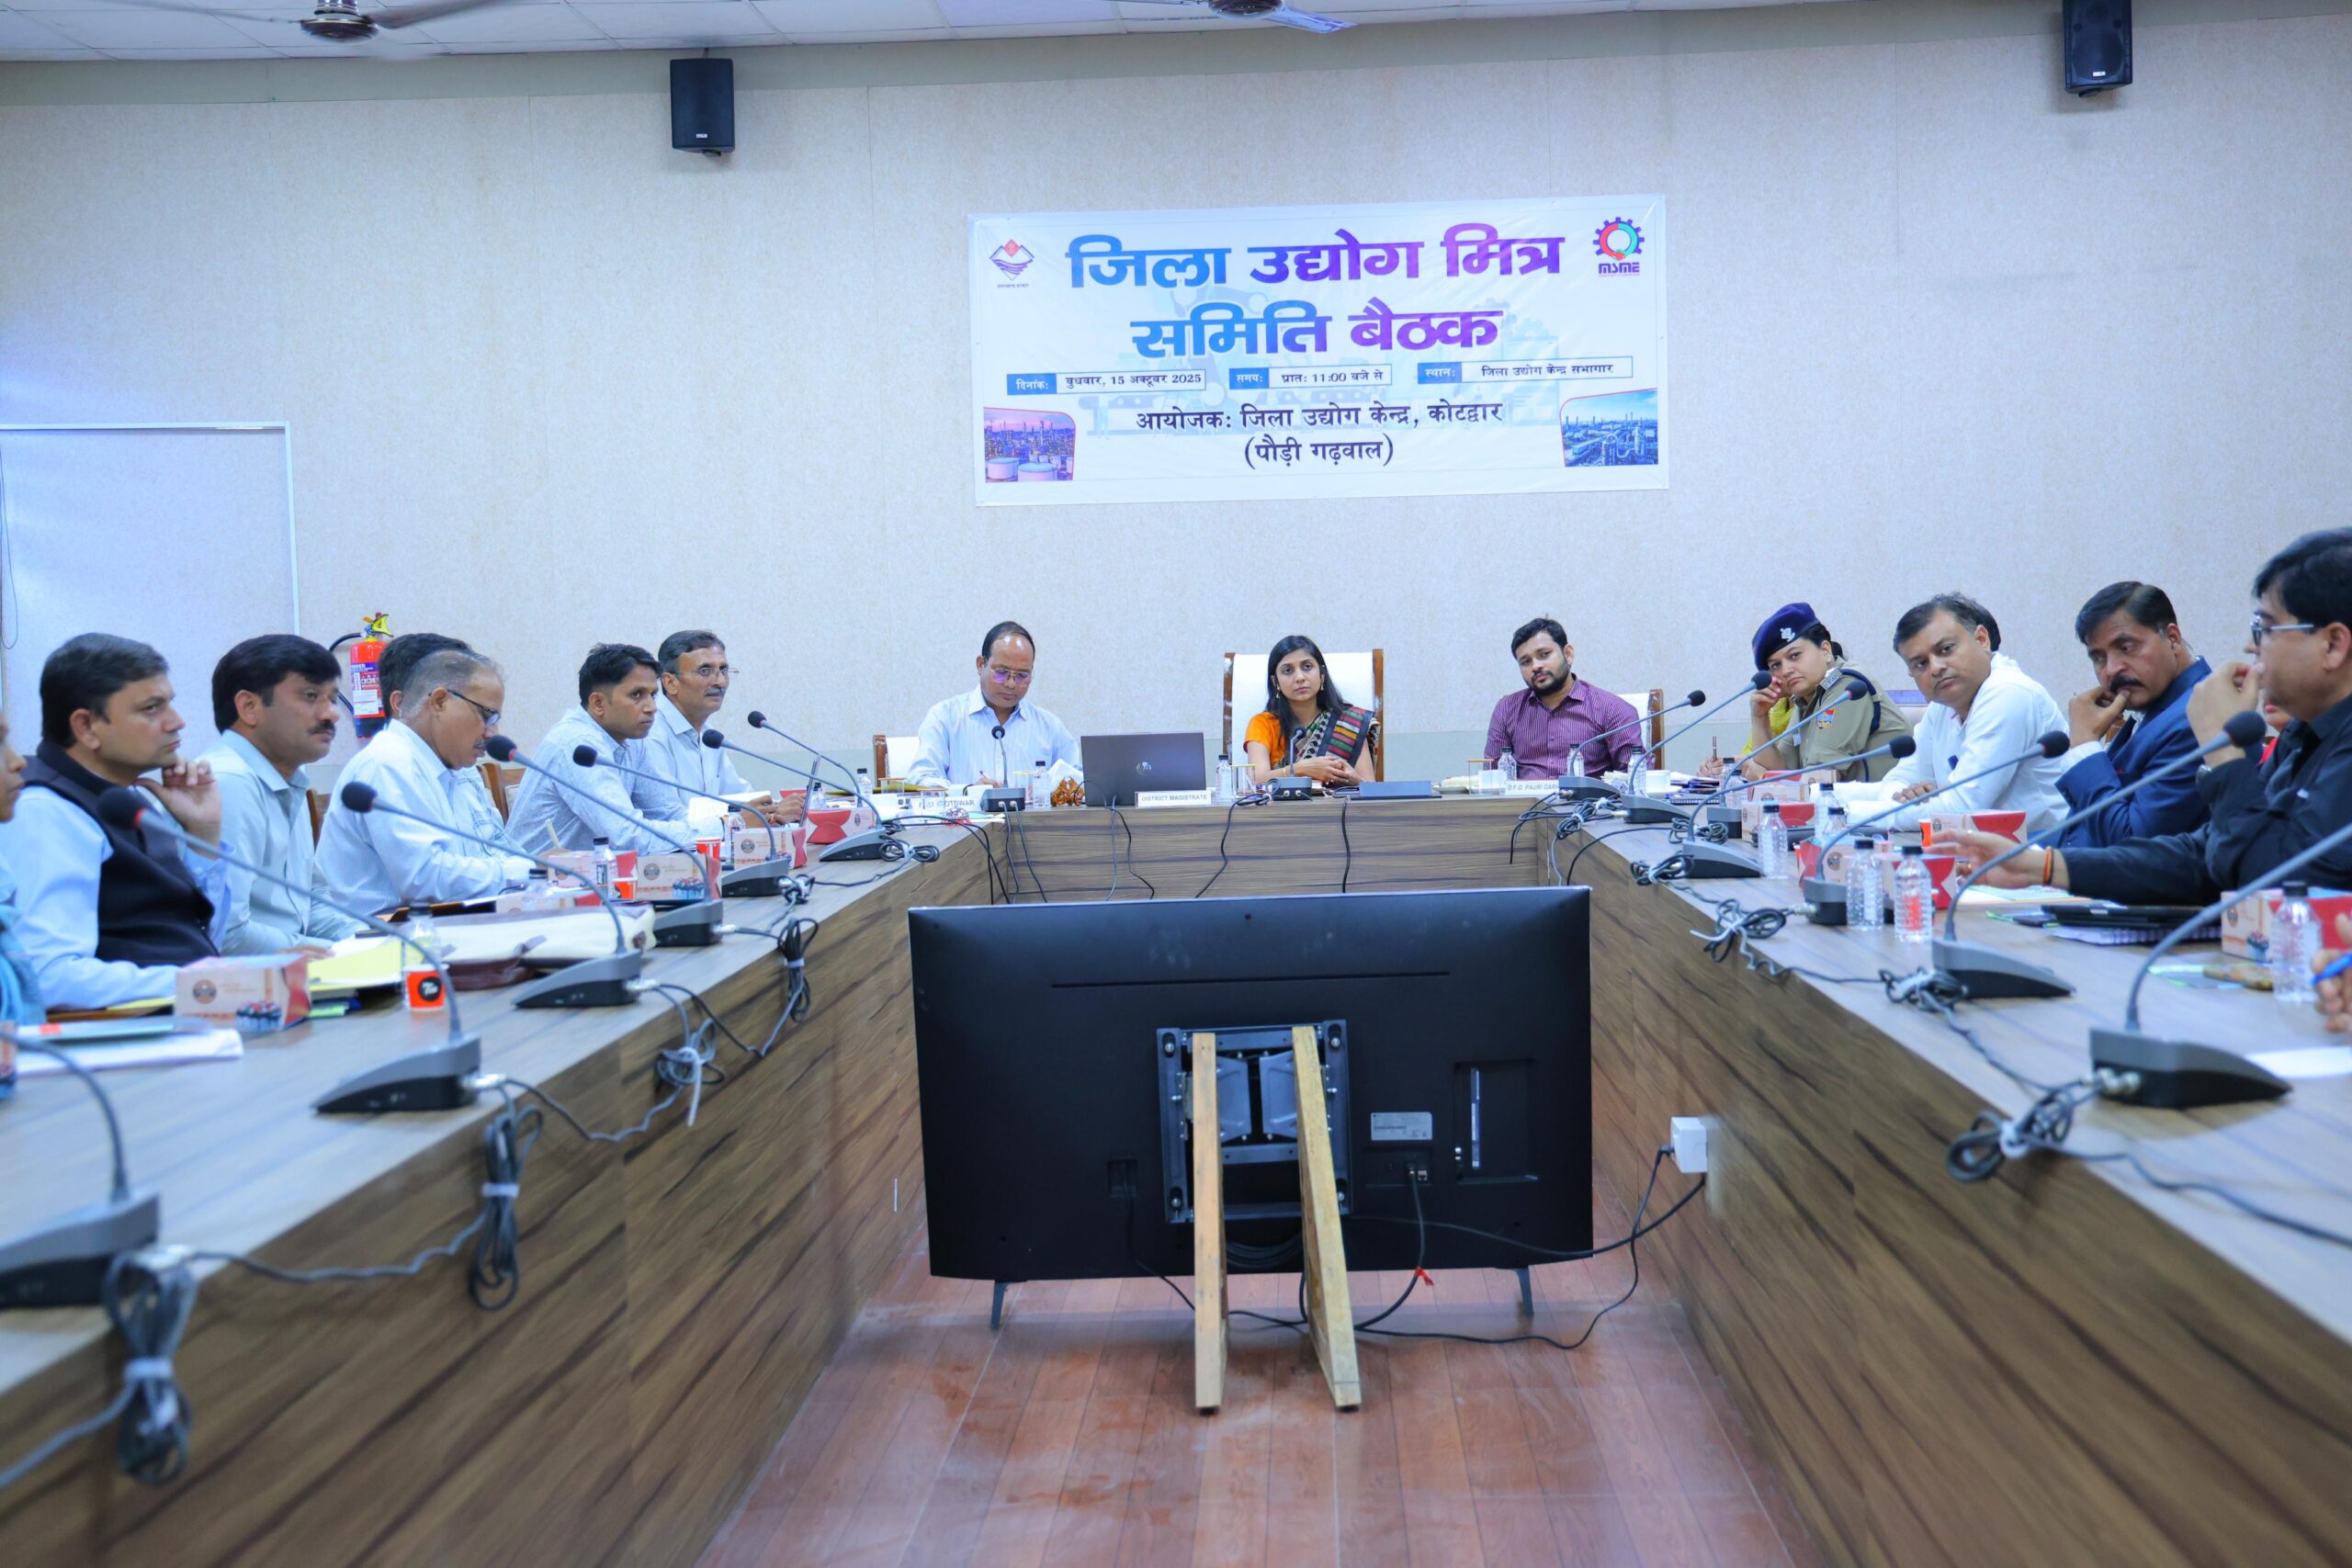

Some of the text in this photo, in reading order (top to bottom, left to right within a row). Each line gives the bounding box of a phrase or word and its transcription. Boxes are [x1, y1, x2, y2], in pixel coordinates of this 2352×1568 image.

[1065, 223, 1566, 288] जिला उद्योग मित्र
[1599, 263, 1639, 274] MSME
[1130, 297, 1503, 358] समिति बैठक
[1172, 375, 1201, 383] 2025
[1314, 373, 1346, 382] 11:00
[1351, 370, 1369, 380] बजे
[1374, 369, 1383, 379] से
[1481, 366, 1508, 376] जिला
[1512, 365, 1542, 376] उद्योग
[1546, 364, 1566, 374] केन्द्र
[1572, 365, 1613, 373] सभागार
[1239, 403, 1294, 427] जिला
[1302, 401, 1361, 425] उद्योग
[1369, 400, 1419, 427] केन्द्र,
[1427, 399, 1503, 422] कोटद्वार
[1245, 434, 1393, 469] (पौड़ी गढ़वाल)
